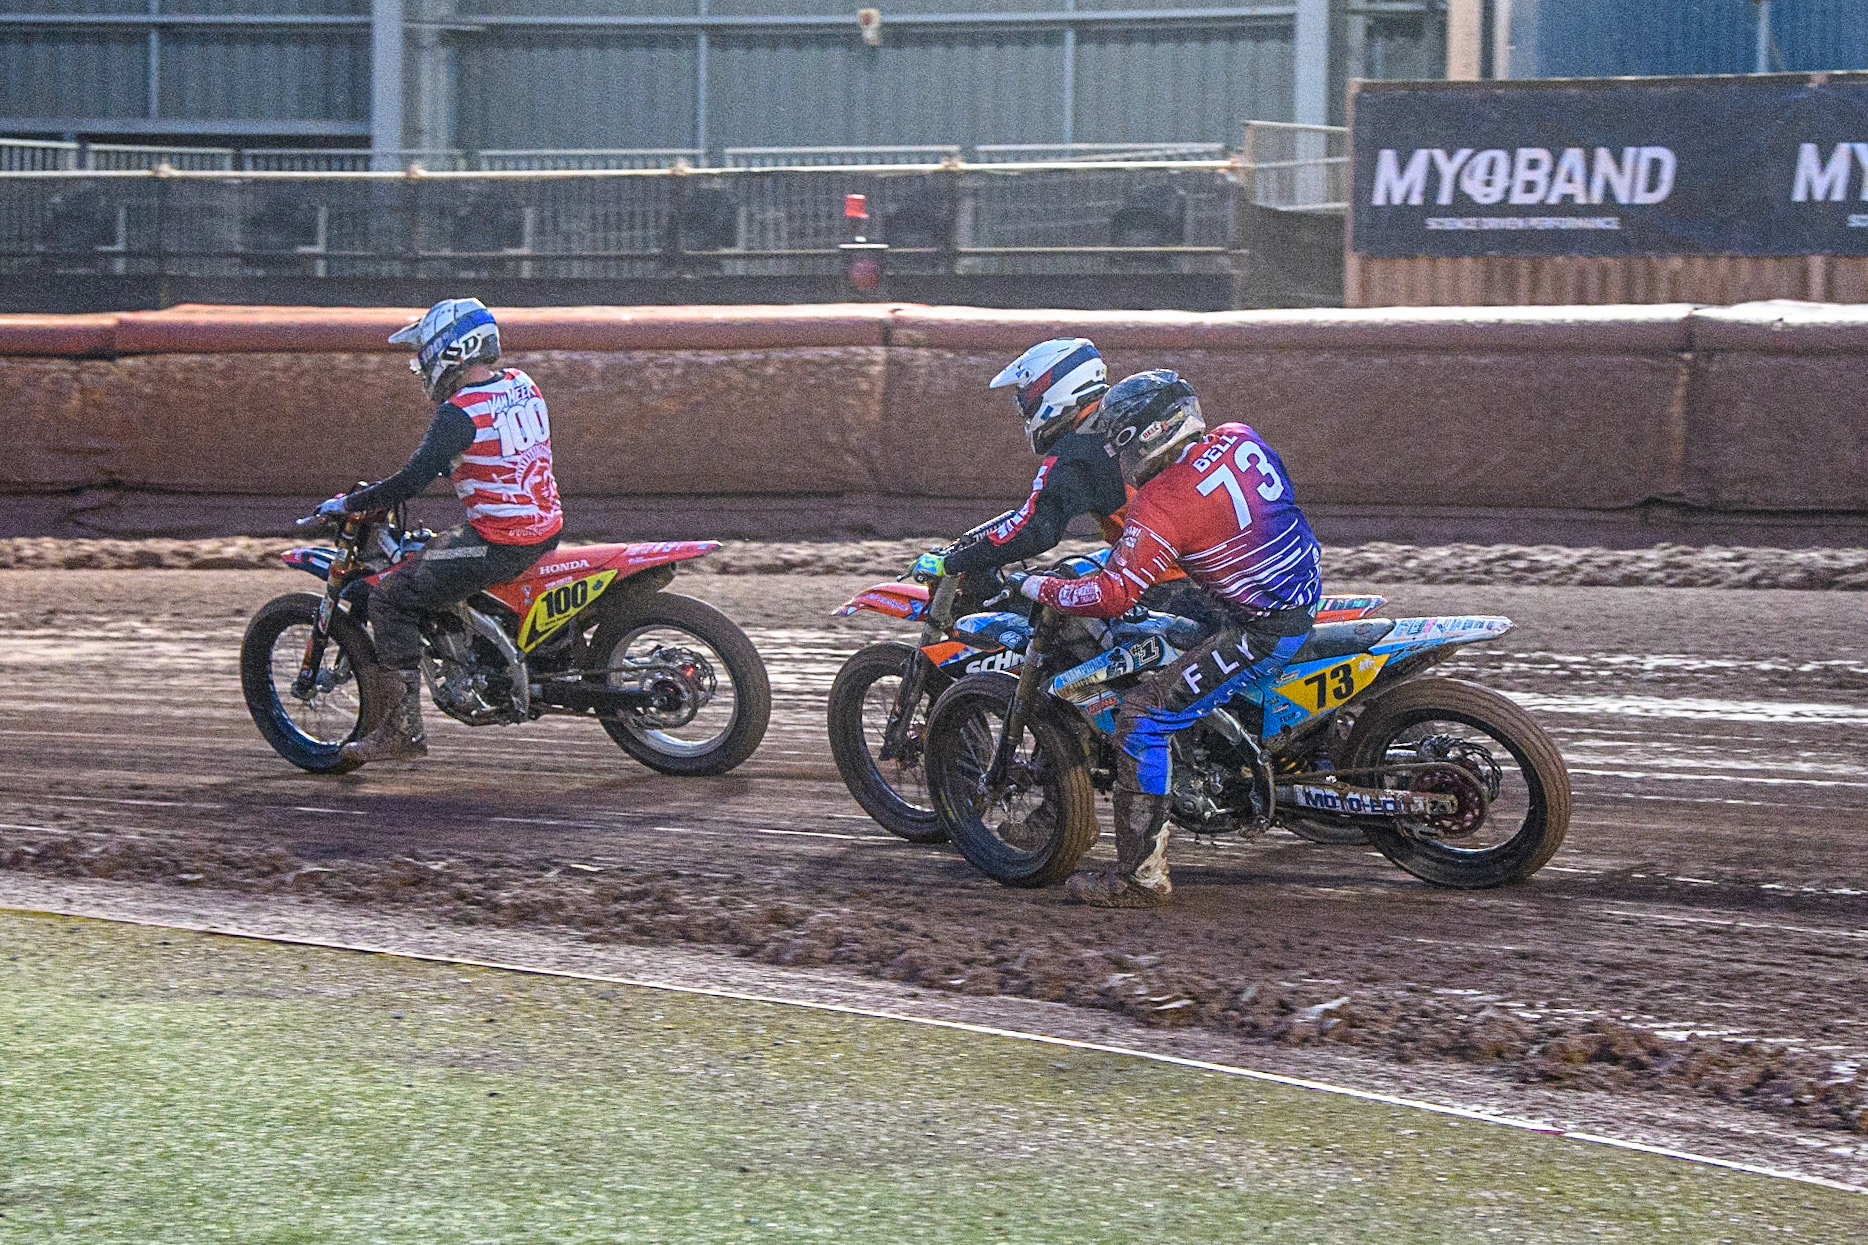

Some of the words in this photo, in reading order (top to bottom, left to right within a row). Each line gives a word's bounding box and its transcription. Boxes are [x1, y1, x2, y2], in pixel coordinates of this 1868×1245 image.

[492, 396, 551, 458] 100
[1192, 434, 1239, 473] BELL
[1195, 440, 1285, 530] 73
[539, 559, 590, 575] HONDA
[541, 580, 588, 618] 100
[1304, 663, 1354, 710] 73
